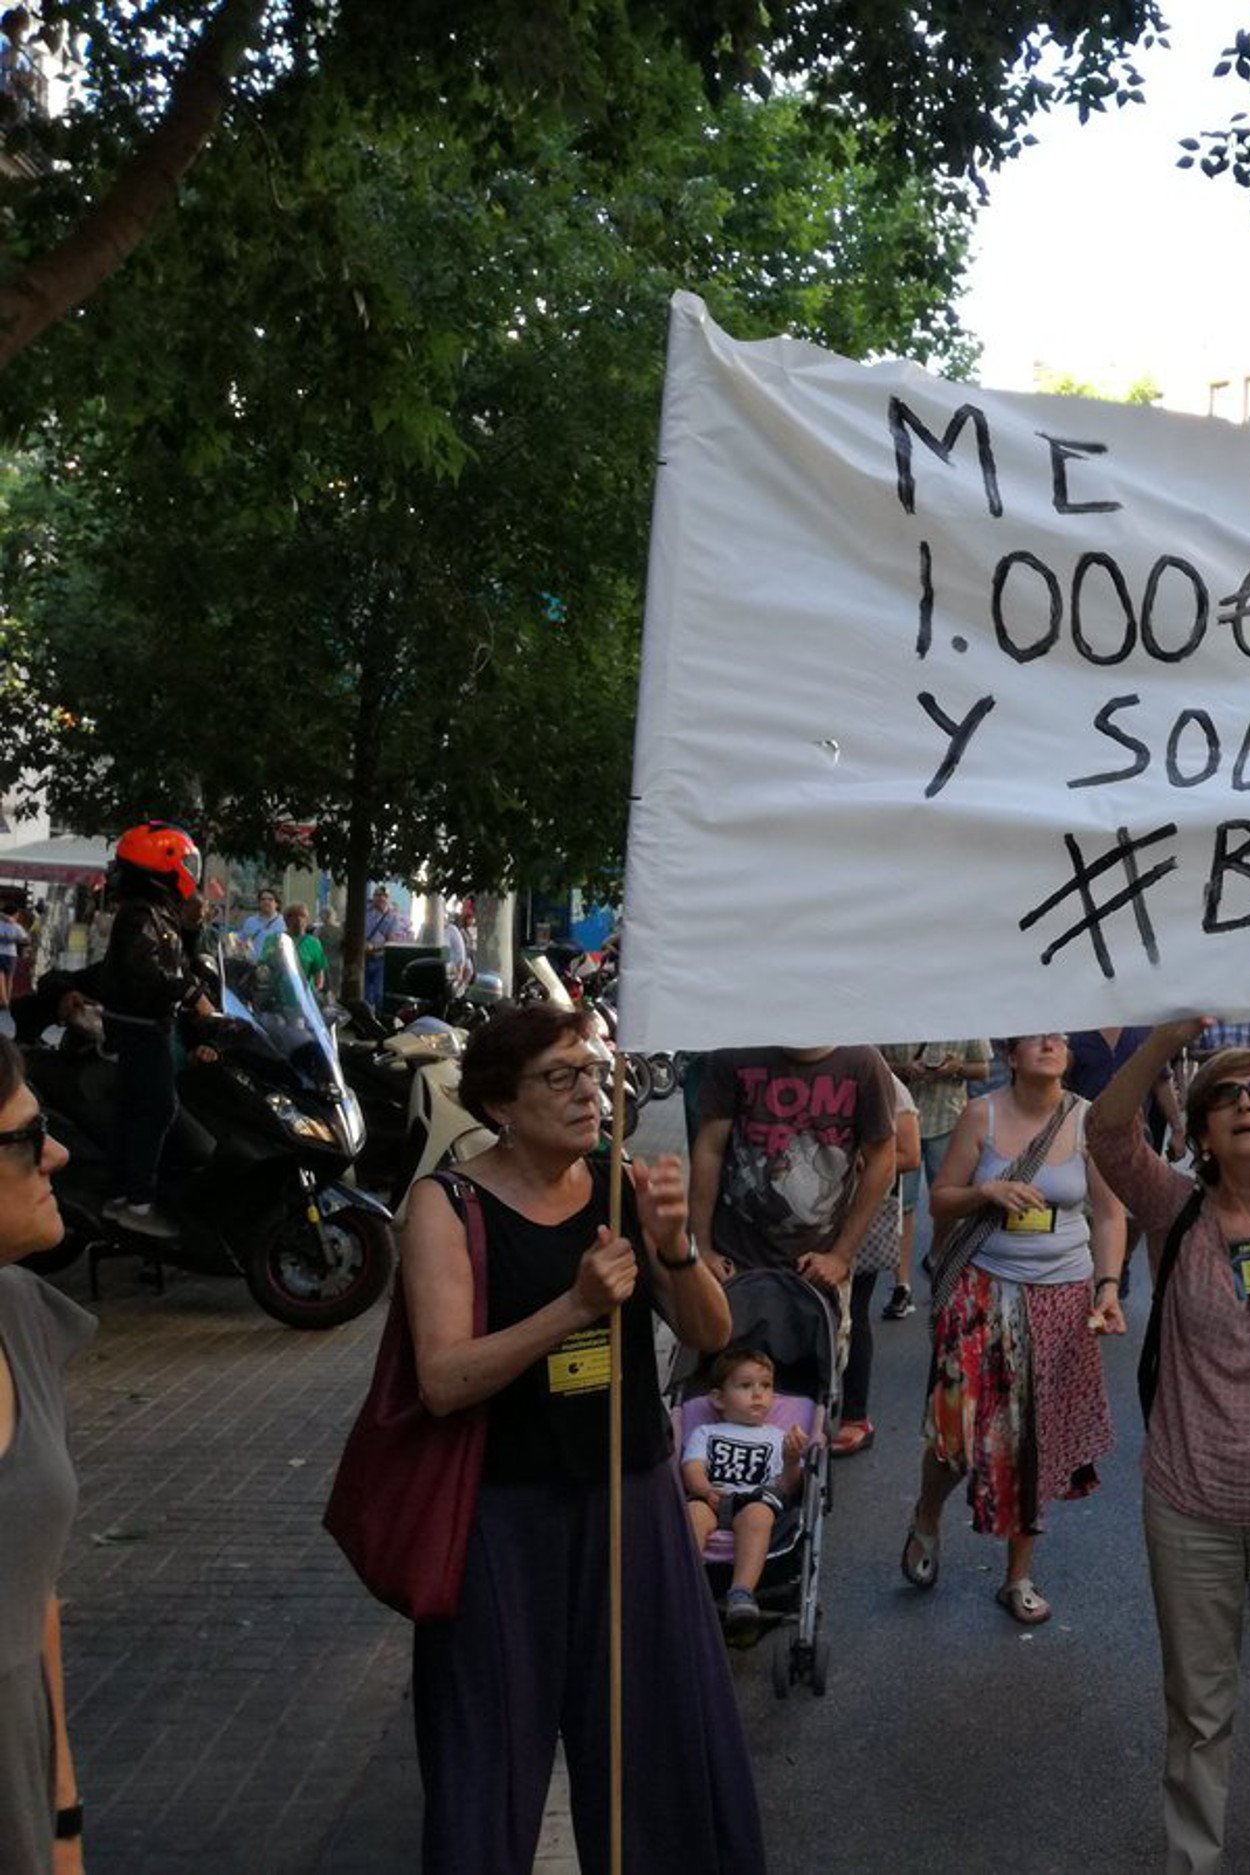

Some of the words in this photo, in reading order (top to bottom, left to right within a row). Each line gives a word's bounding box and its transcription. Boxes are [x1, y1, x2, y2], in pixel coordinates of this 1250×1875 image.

[889, 396, 1122, 518] ME
[917, 691, 997, 798] Y
[736, 1066, 858, 1119] TOM
